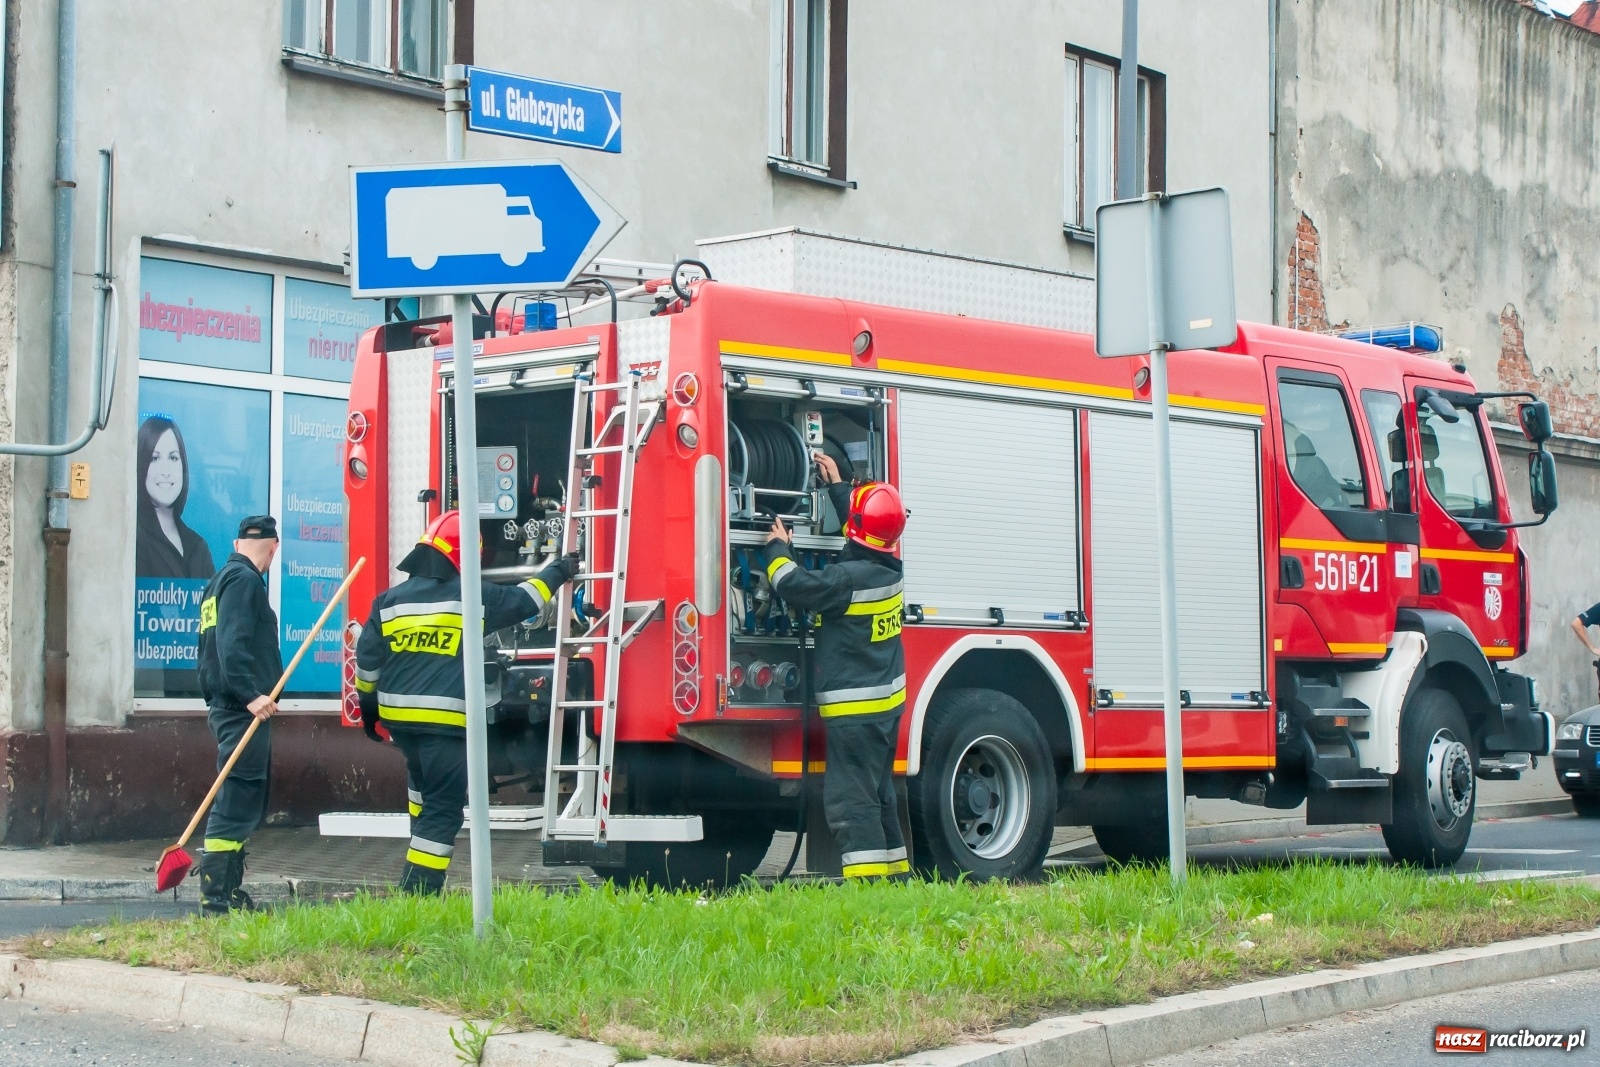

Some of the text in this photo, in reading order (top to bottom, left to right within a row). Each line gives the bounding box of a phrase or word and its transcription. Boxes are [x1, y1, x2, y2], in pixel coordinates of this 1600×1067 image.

[481, 84, 585, 135] ul. Głubczycka
[1314, 552, 1347, 591] 561
[1359, 554, 1378, 593] 21
[137, 581, 189, 610] produkty
